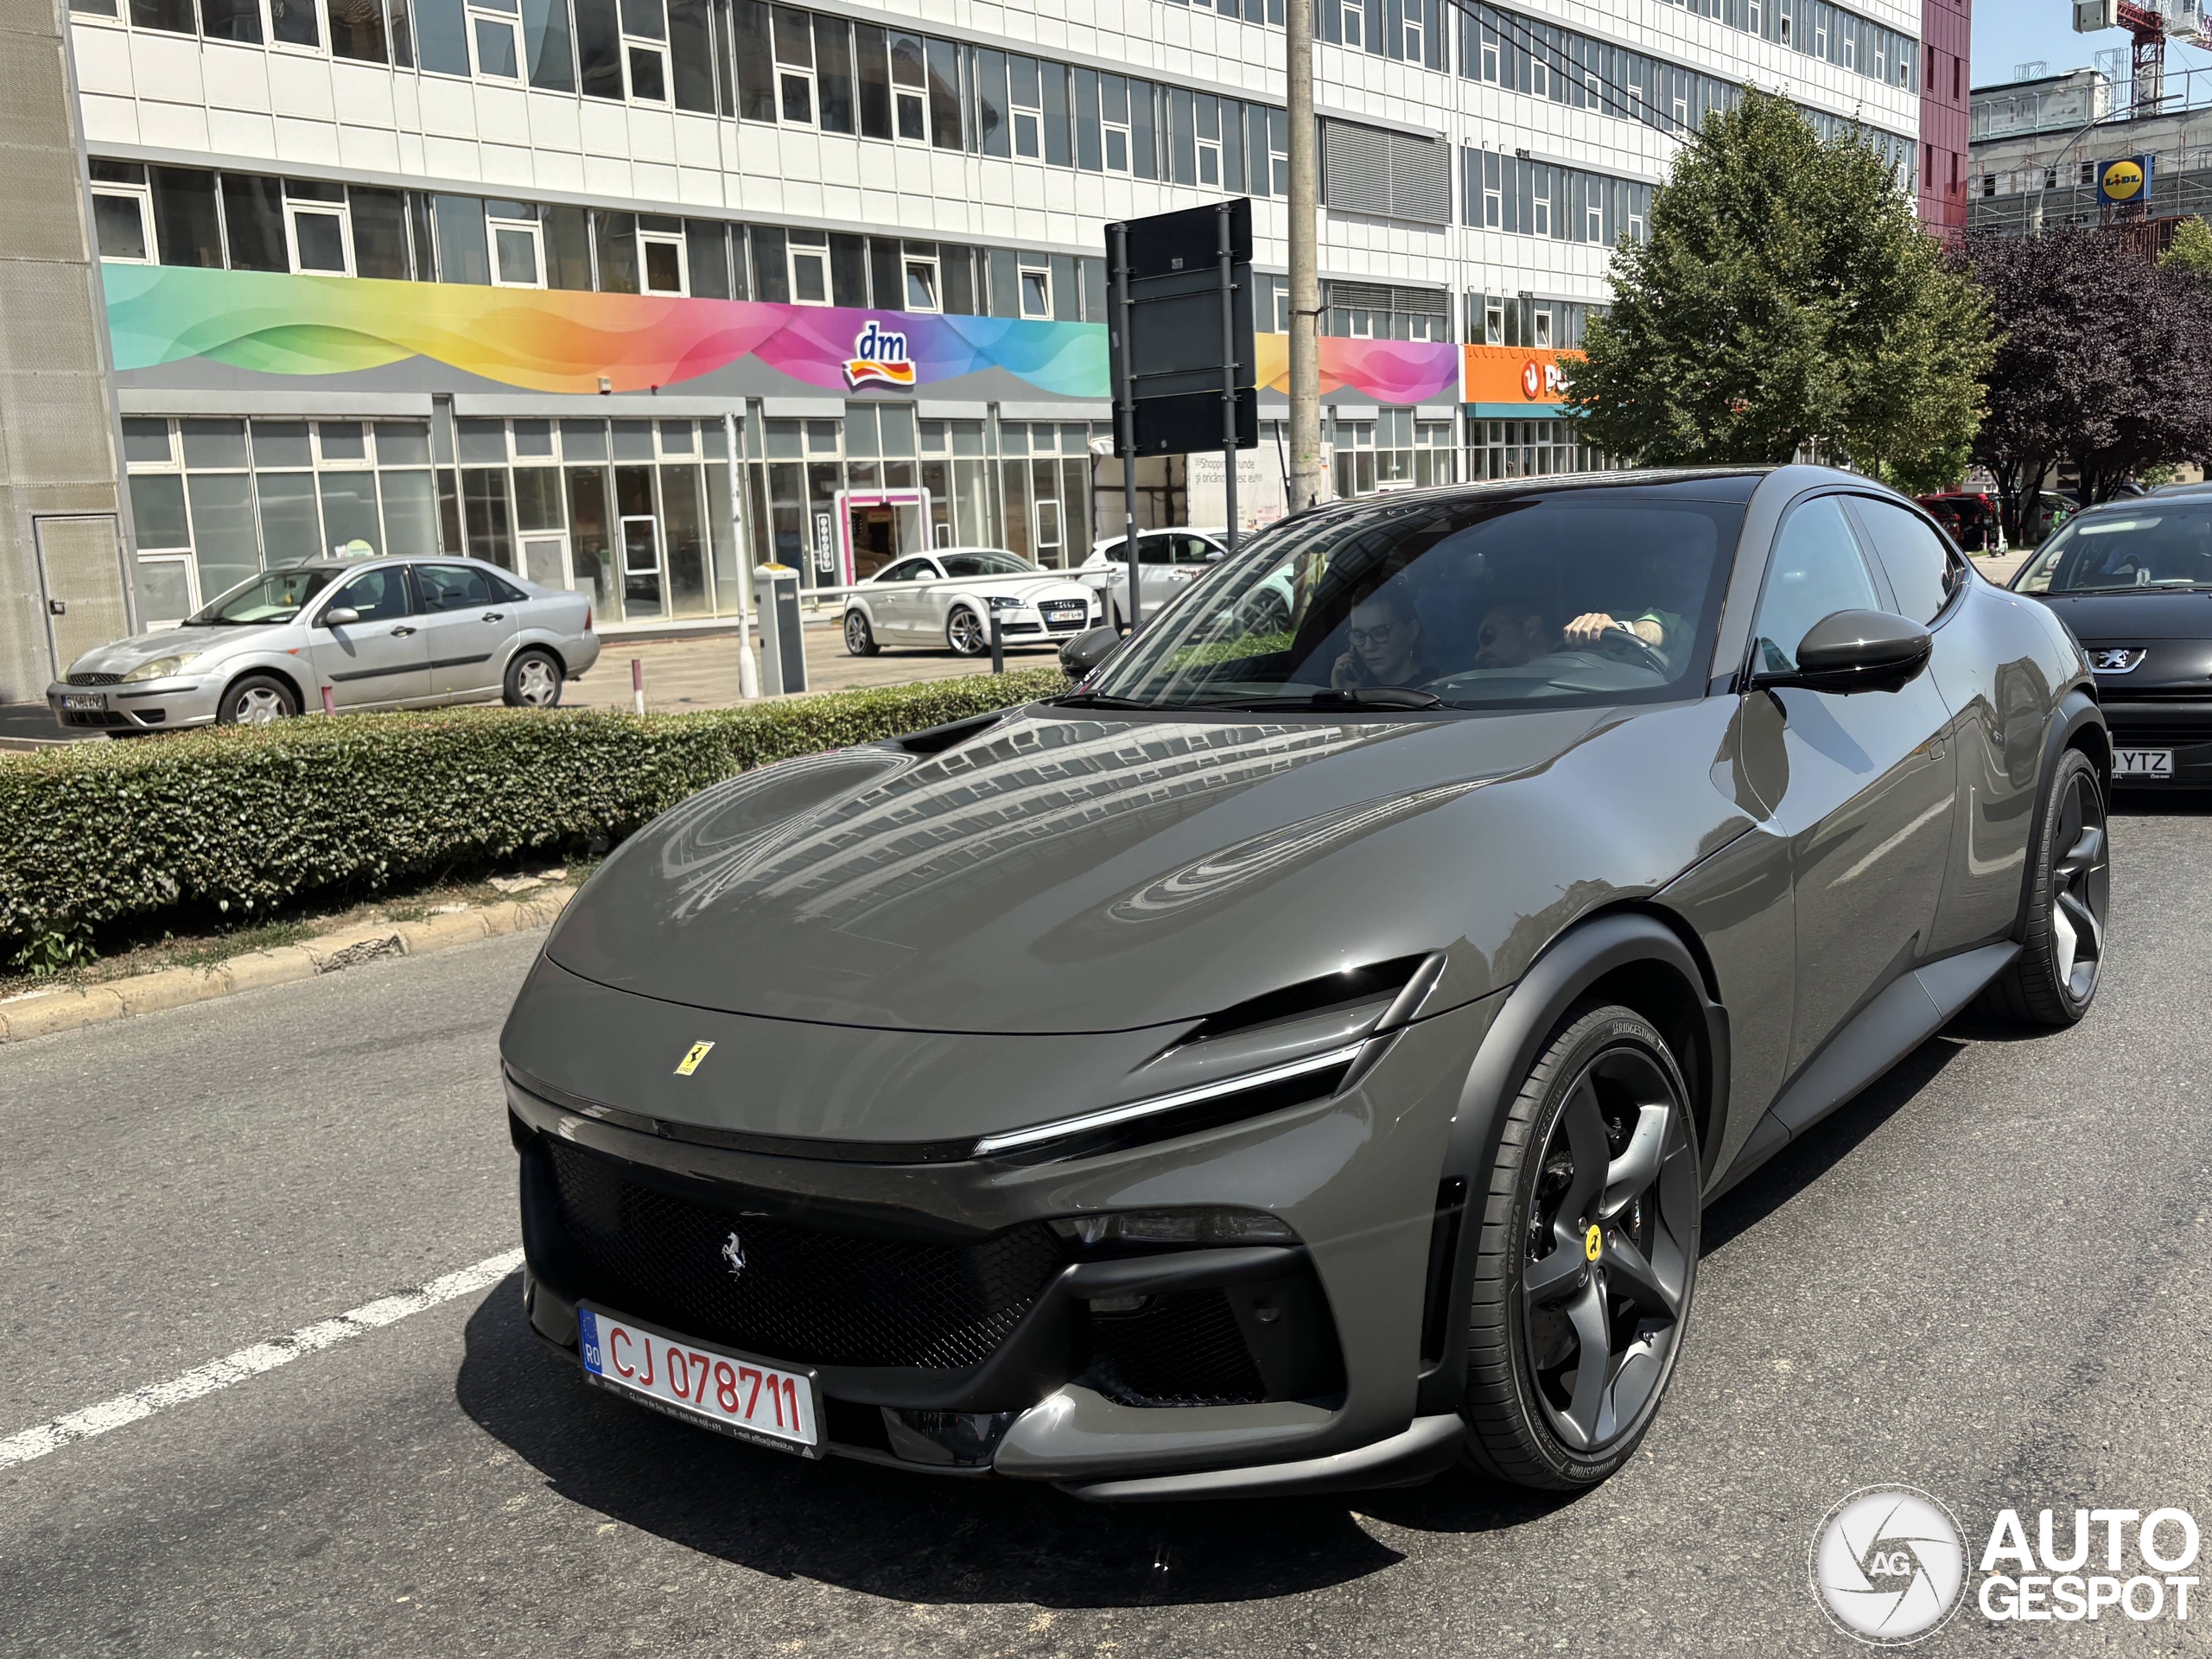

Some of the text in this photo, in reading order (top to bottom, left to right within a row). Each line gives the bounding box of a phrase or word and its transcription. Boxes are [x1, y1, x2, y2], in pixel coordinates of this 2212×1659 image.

[860, 325, 904, 360] dm
[2122, 753, 2167, 771] YTZ
[1612, 1020, 1657, 1046] BRIDGESTONE
[1508, 1205, 1521, 1274] POTENZA
[585, 1344, 601, 1366] RO
[610, 1327, 804, 1433] CJ 078711
